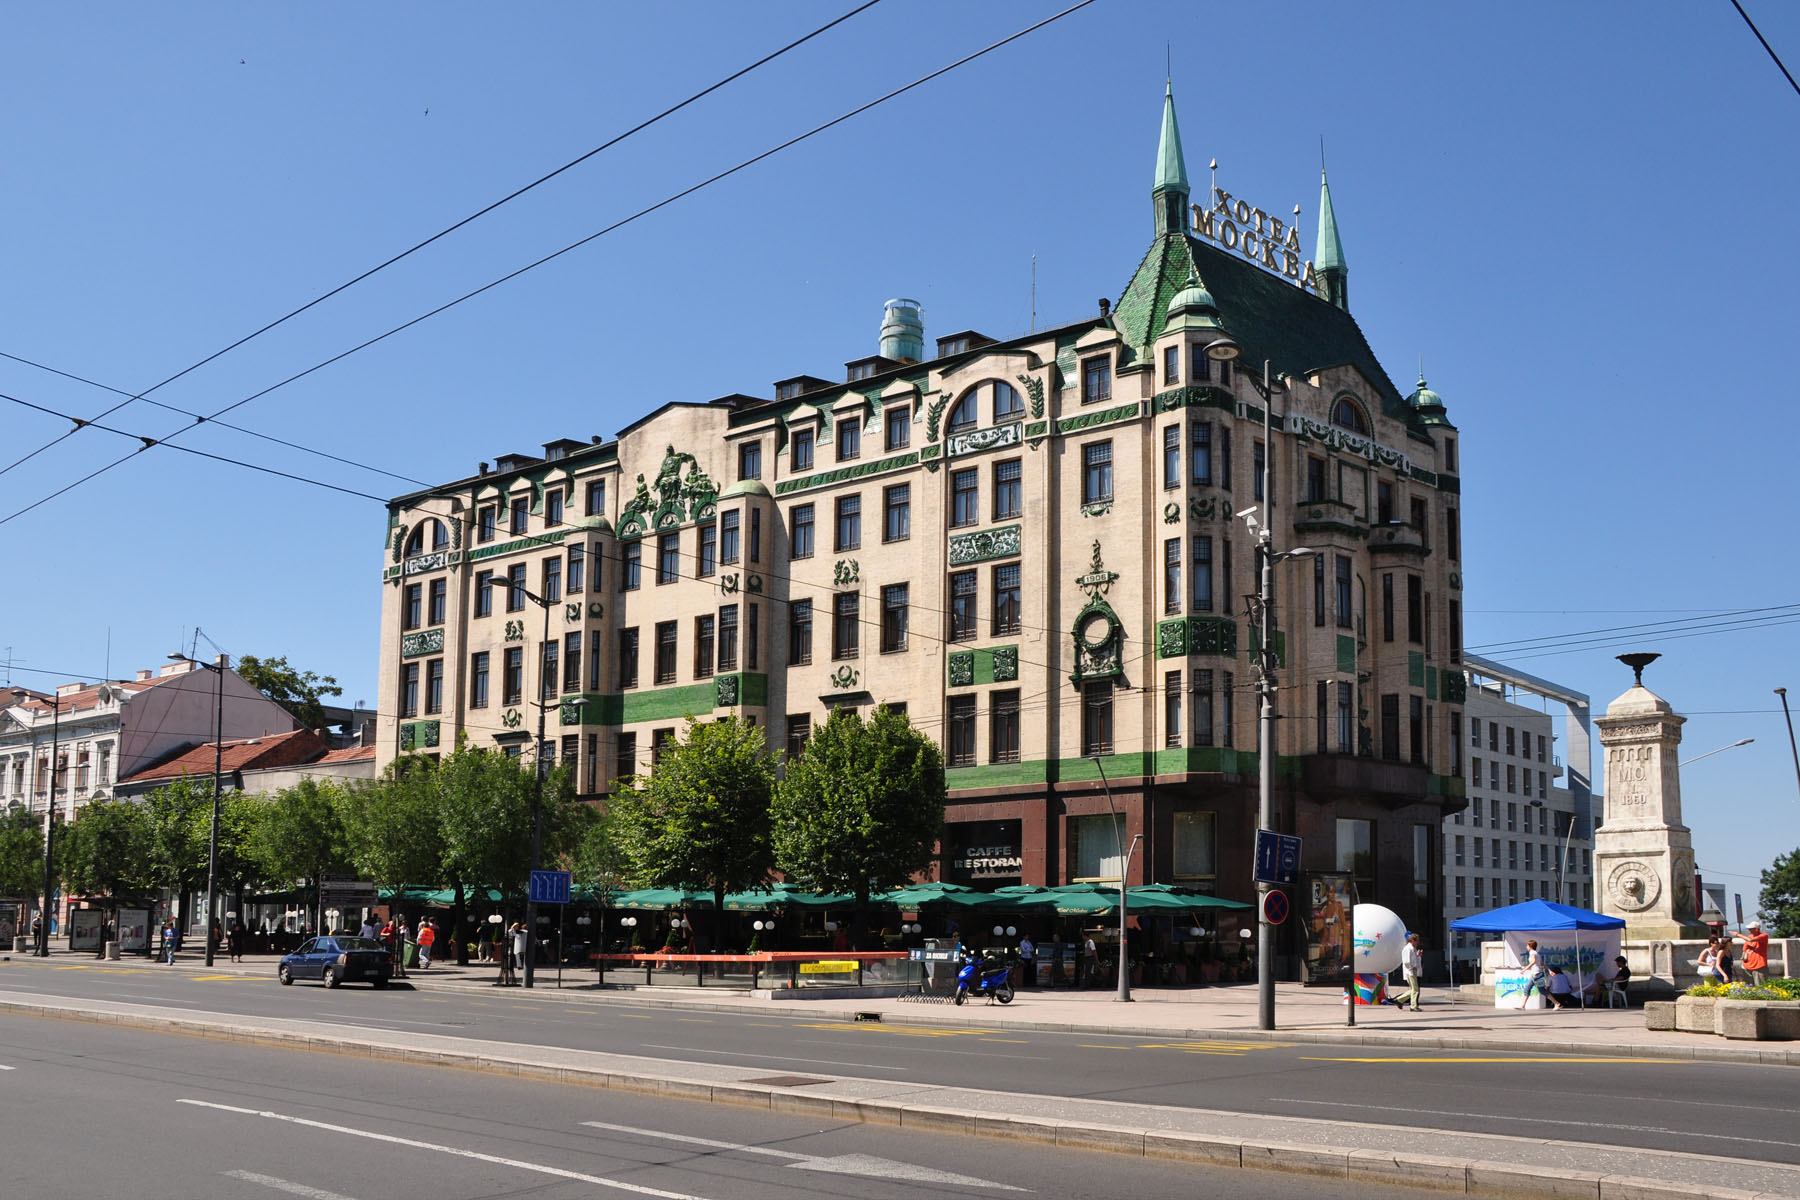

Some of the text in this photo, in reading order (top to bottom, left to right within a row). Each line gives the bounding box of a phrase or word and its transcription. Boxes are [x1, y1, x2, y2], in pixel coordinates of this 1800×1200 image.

[1191, 203, 1319, 291] МОСКВА
[1086, 573, 1107, 583] 1906
[966, 846, 1012, 857] CAFFE
